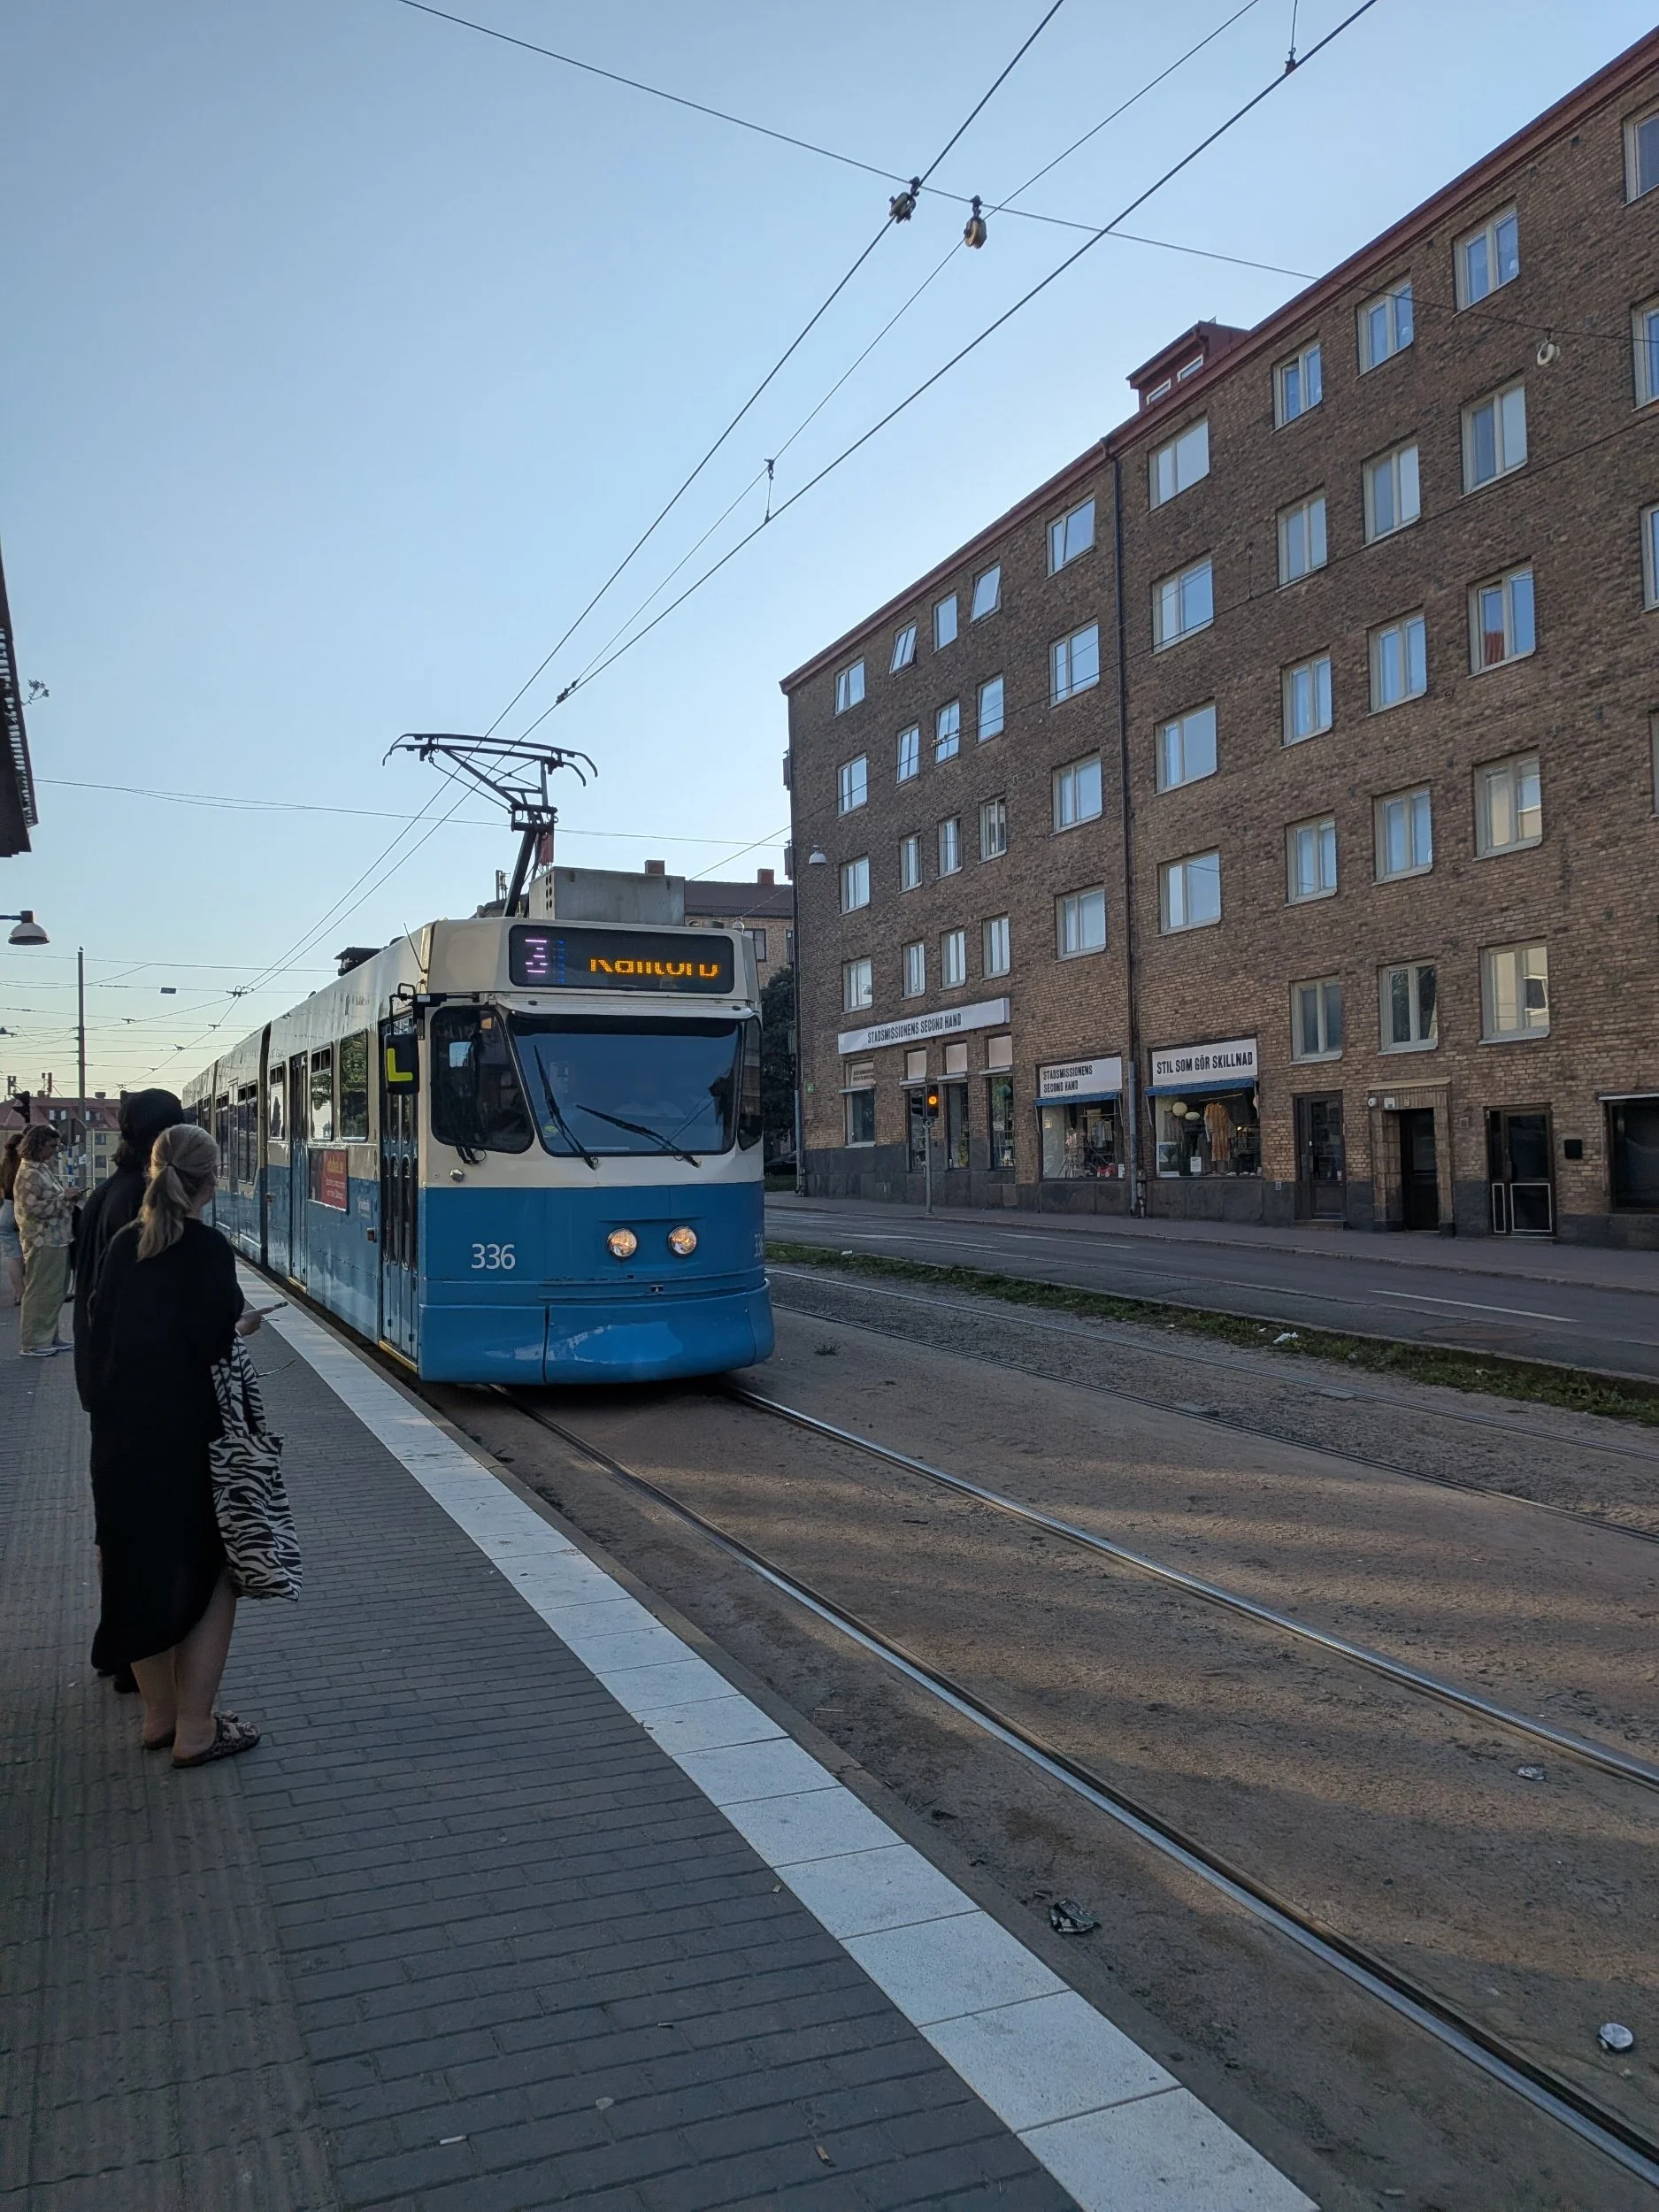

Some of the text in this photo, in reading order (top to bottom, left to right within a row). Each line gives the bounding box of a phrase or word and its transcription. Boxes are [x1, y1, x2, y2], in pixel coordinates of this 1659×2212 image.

[867, 1012, 962, 1044] STADSMISSIONENS SECOND HAND
[1043, 1064, 1093, 1080] STADSMISSIONENS
[1156, 1051, 1253, 1075] STIL SOM GÖR SKILLNAD
[1043, 1079, 1079, 1094] SECOND HAND
[471, 1243, 516, 1270] 336
